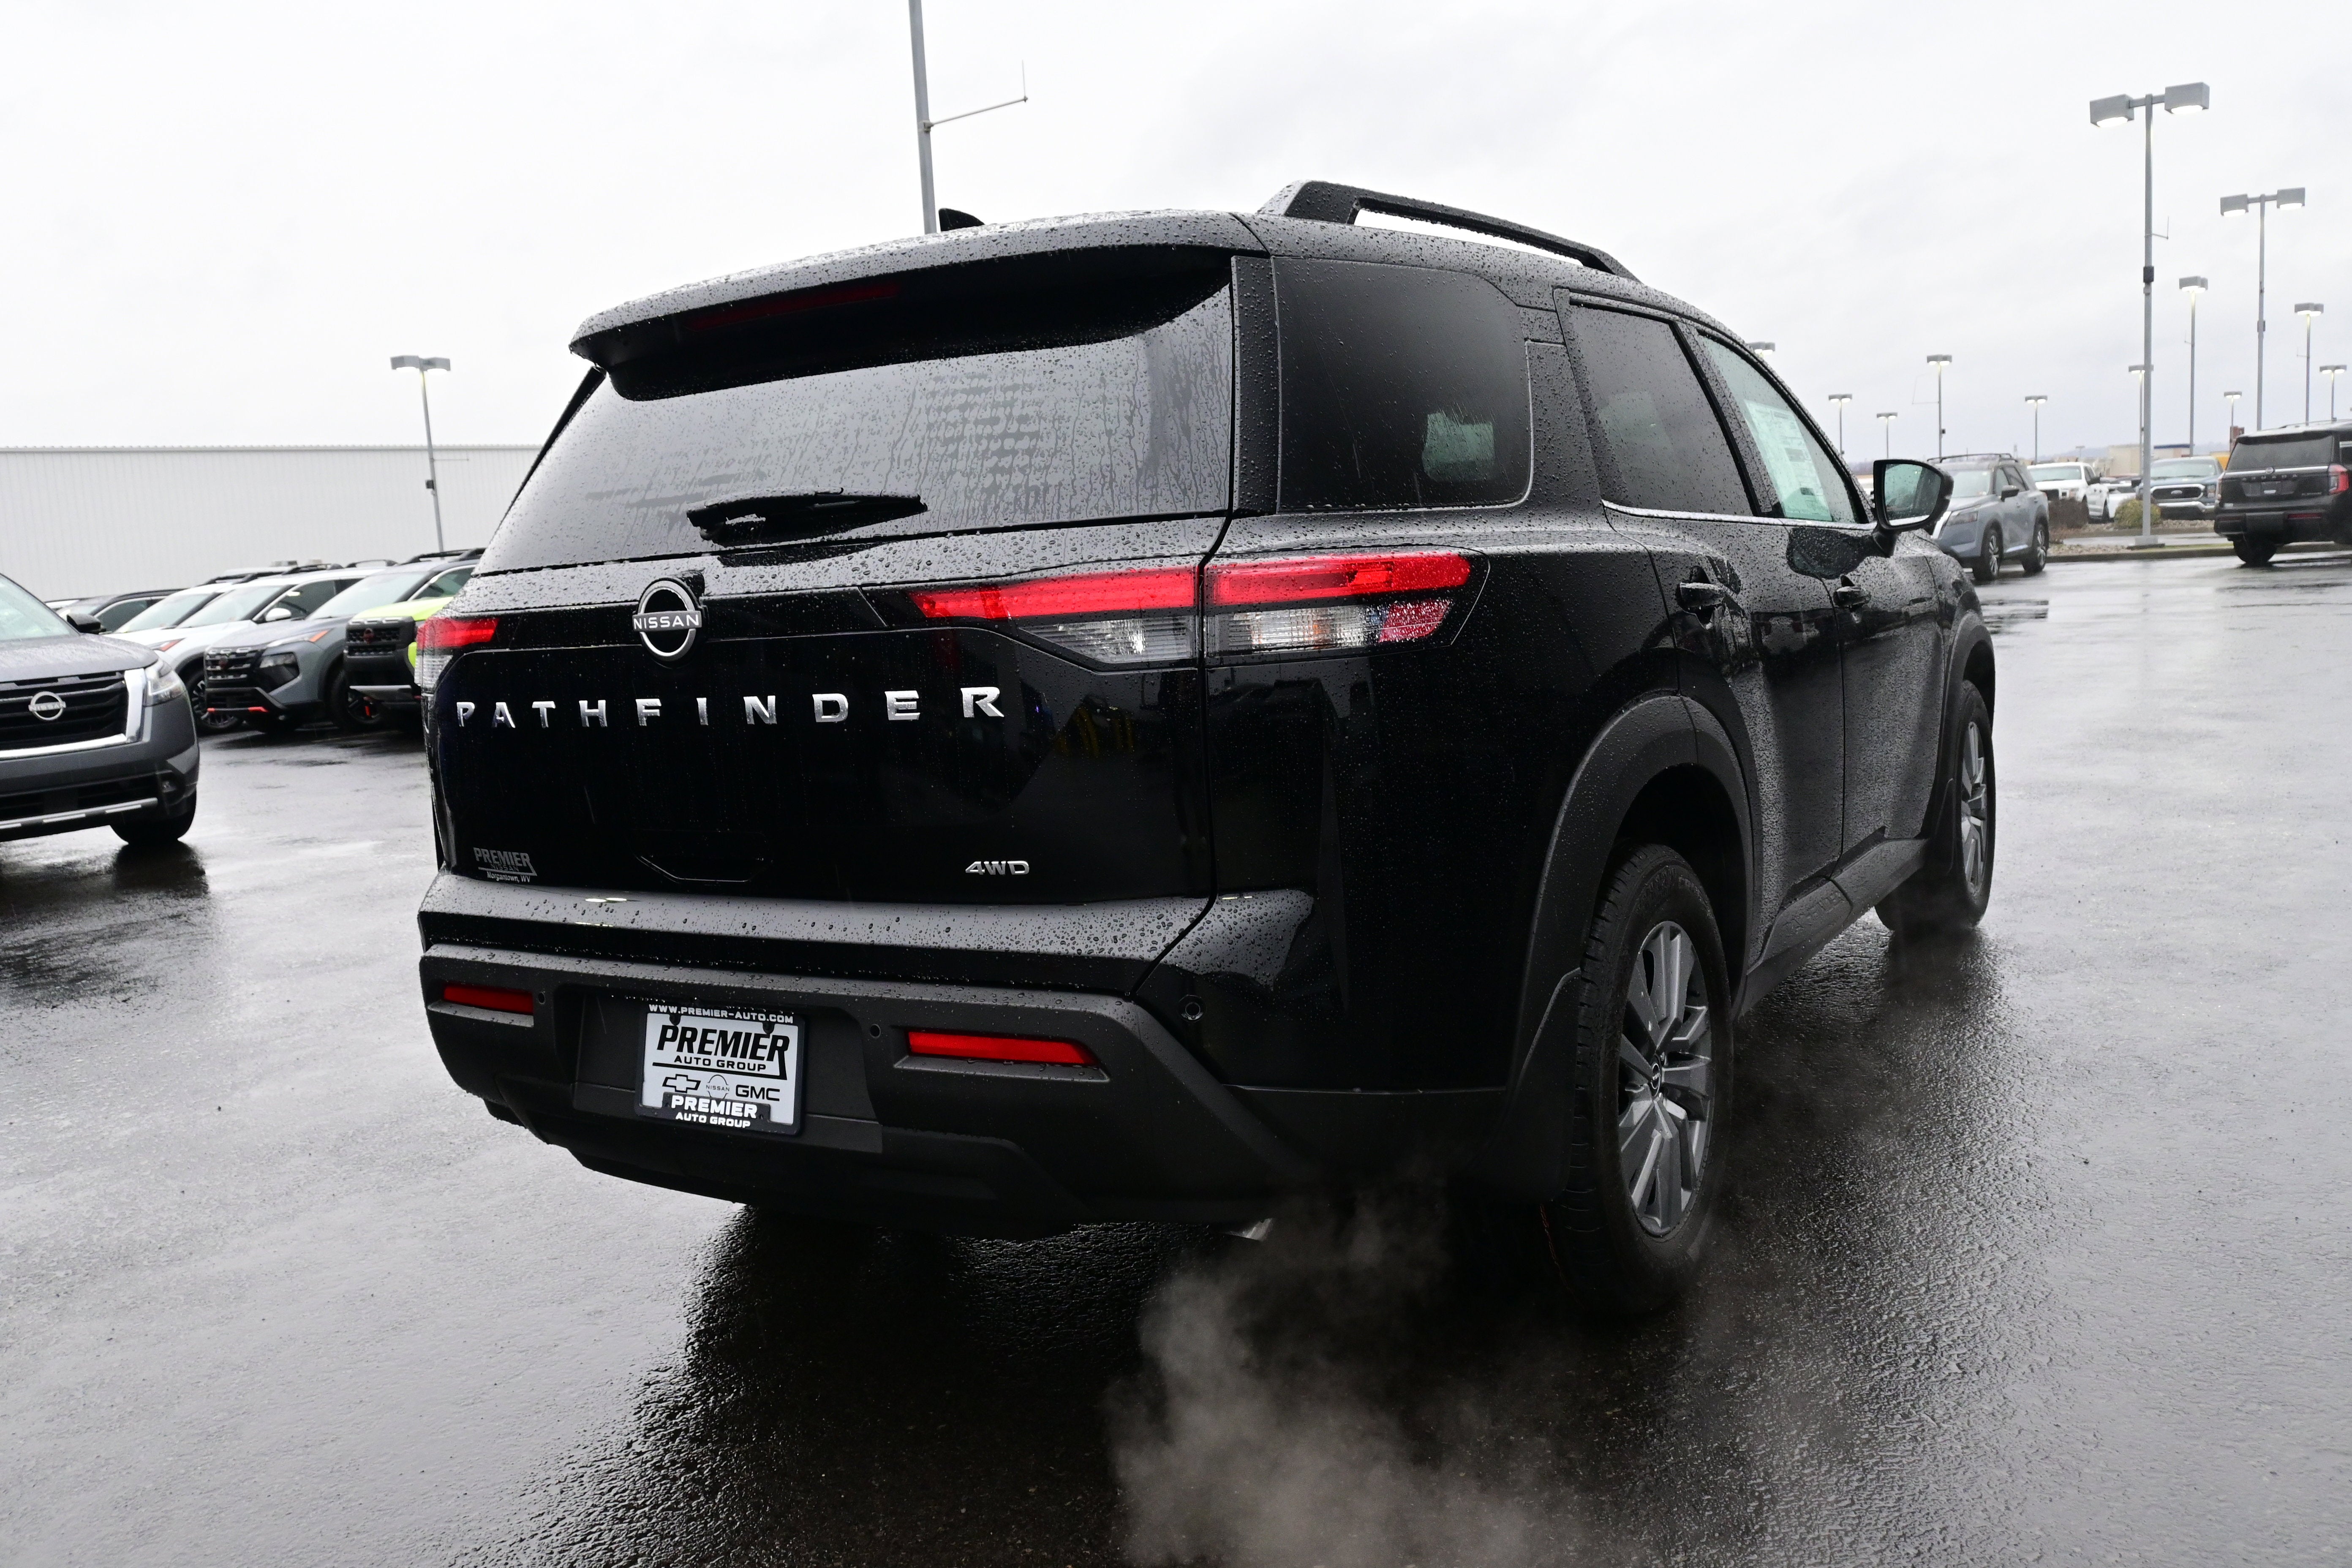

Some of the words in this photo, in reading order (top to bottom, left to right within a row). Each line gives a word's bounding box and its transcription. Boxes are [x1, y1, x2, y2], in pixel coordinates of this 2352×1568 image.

[633, 614, 700, 629] NISSAN
[30, 702, 66, 711] NISSAN
[456, 686, 1004, 728] PATHFINDER
[473, 847, 531, 866] PREMIER
[491, 864, 520, 872] NISSAN
[965, 860, 1029, 875] 4WD
[487, 871, 520, 883] Morgantown,
[649, 1004, 793, 1024] WWW.PREMIER-AUTO.COM
[657, 1024, 790, 1062] PREMIER
[674, 1055, 711, 1066] AUTO
[716, 1059, 766, 1072] GROUP
[735, 1085, 780, 1102] GMC
[671, 1095, 757, 1119] PREMIER
[675, 1112, 707, 1124] AUTO
[710, 1116, 751, 1129] GROUP
